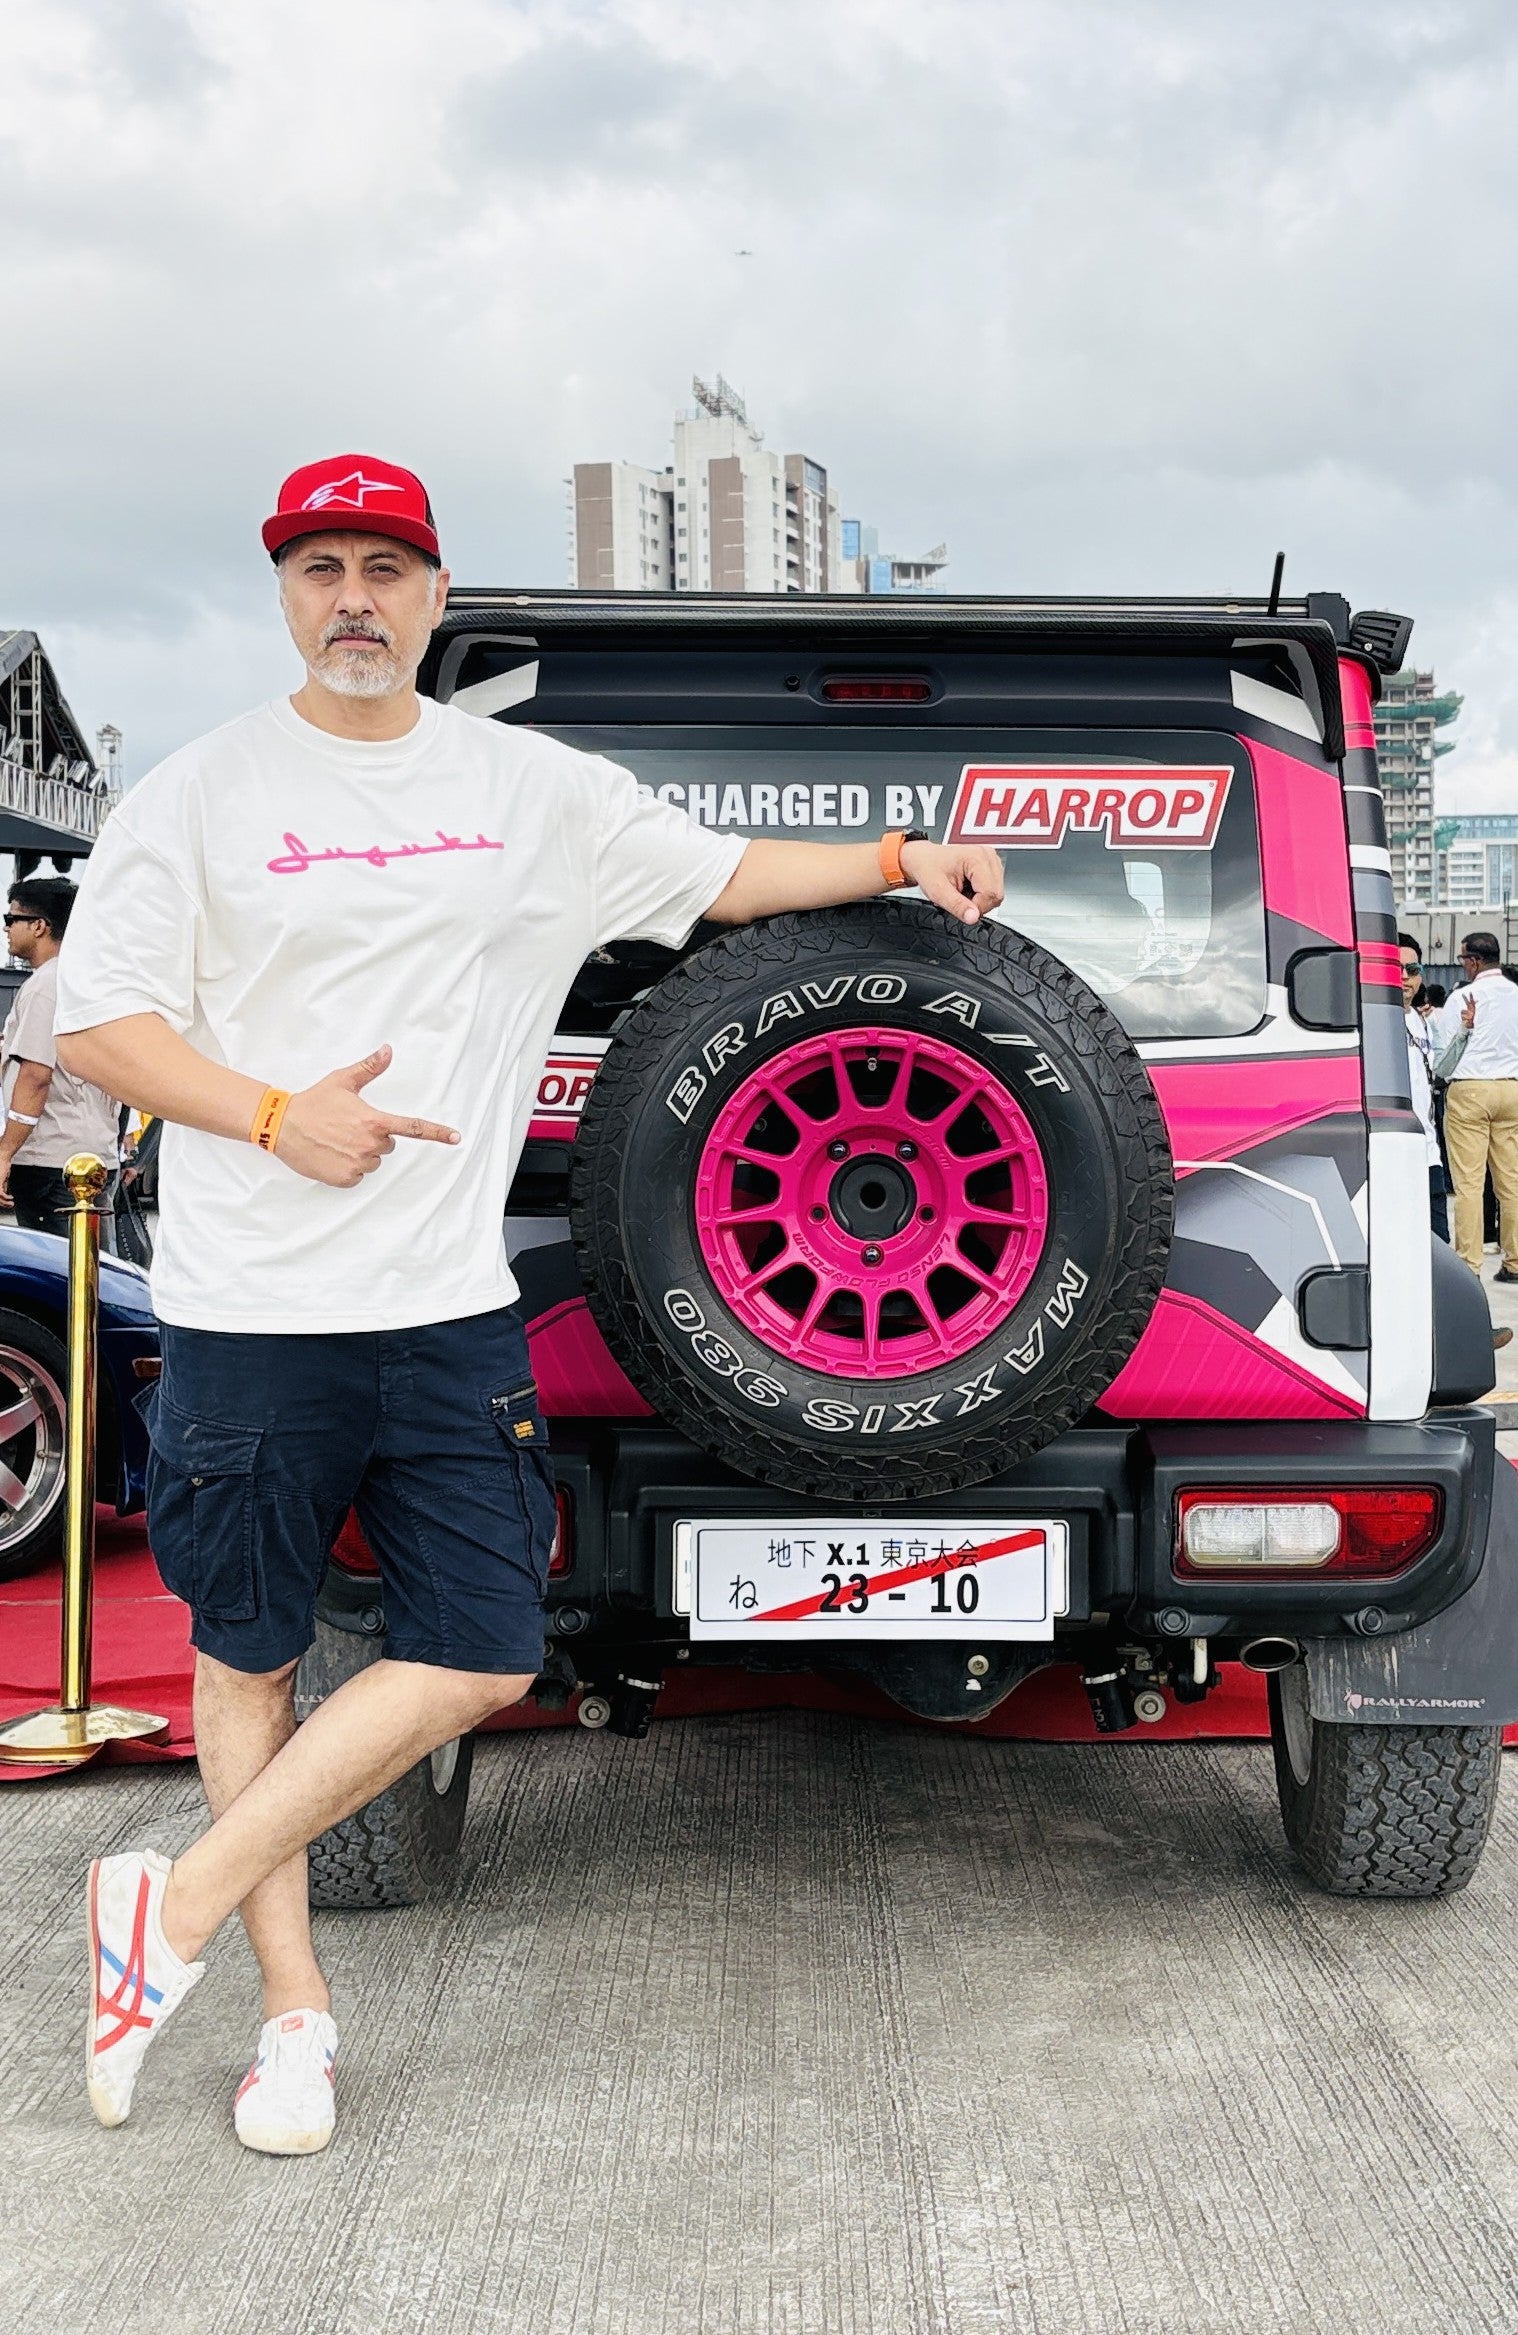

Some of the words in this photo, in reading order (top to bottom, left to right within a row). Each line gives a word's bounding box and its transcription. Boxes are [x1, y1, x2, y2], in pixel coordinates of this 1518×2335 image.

[885, 785, 944, 827] BY
[973, 788, 1205, 828] HARROP
[666, 974, 907, 1124] BRAVO
[923, 991, 1072, 1094] A/T
[897, 1232, 951, 1284] LENSO
[663, 1288, 789, 1408] 980
[802, 1258, 1090, 1435] MAXXIS
[767, 1538, 817, 1569] 地下
[826, 1543, 870, 1567] X.1
[880, 1538, 979, 1569] 東京大会
[729, 1574, 759, 1610] ね
[820, 1573, 869, 1614] 23
[931, 1572, 979, 1614] 10
[1363, 1697, 1482, 1709] RALLYARMOR
